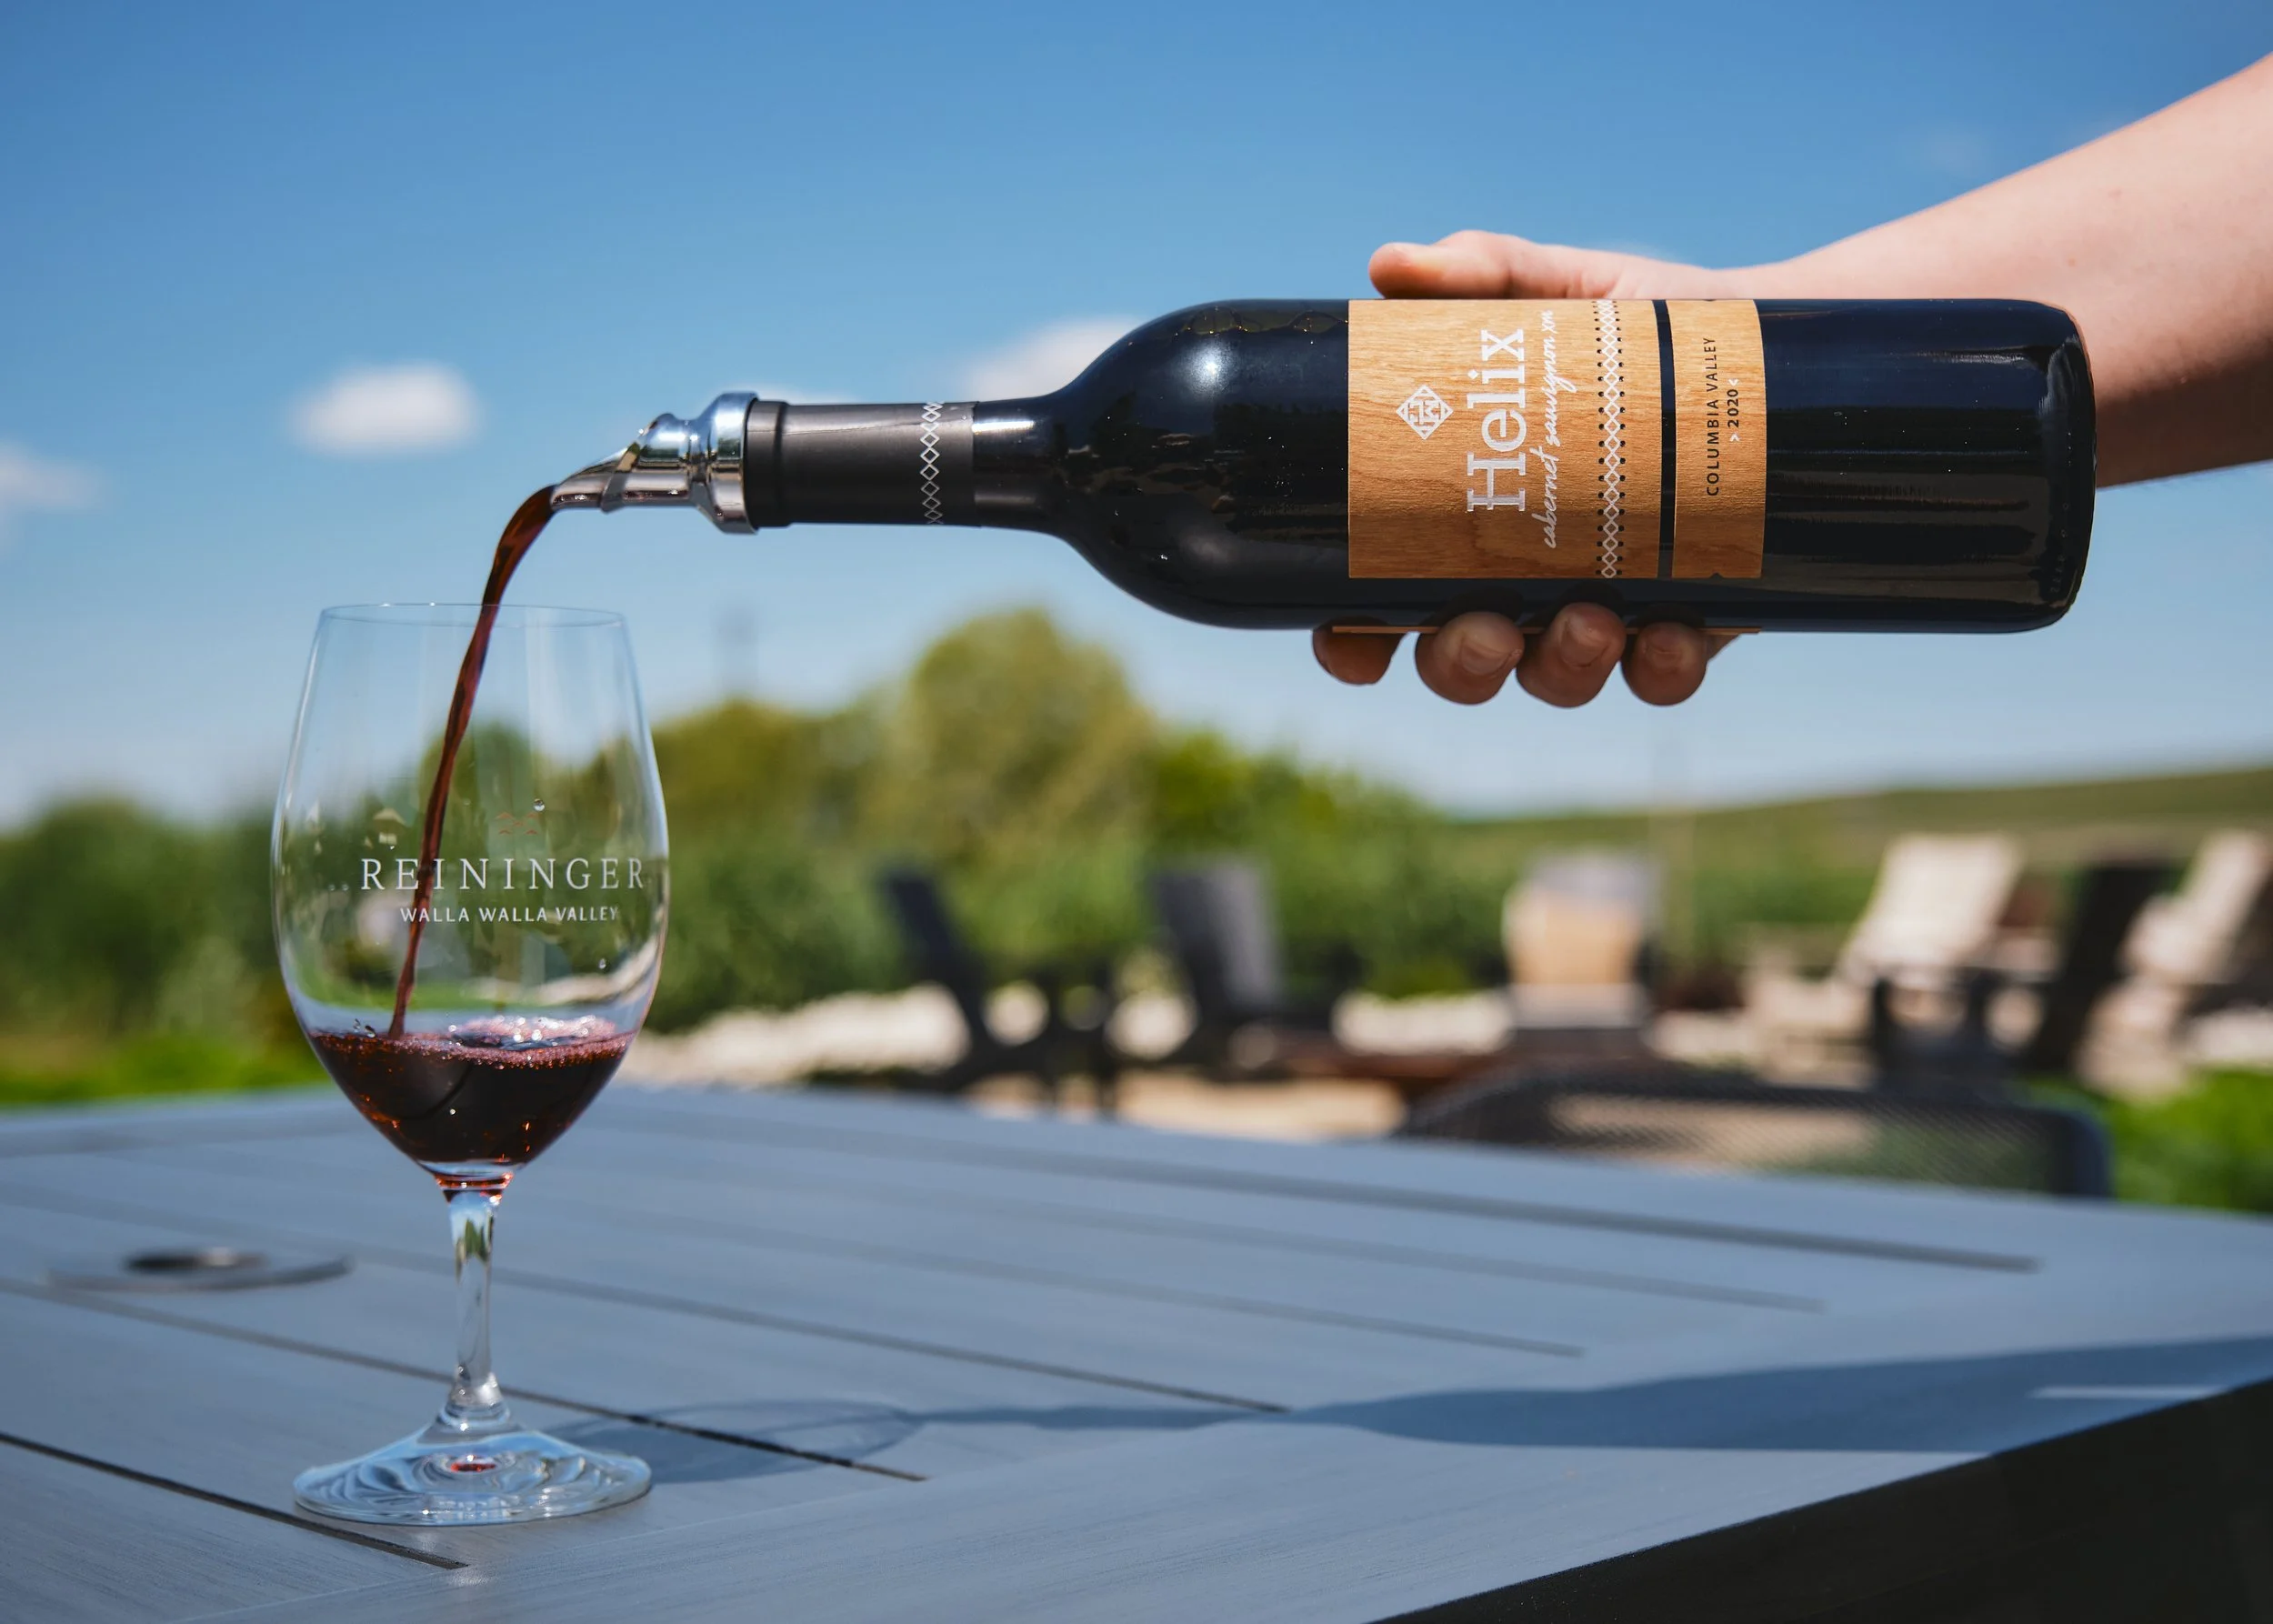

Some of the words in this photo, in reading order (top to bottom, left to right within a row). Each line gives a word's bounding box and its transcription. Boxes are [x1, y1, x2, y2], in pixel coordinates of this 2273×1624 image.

[1541, 336, 1577, 446] sauvignon
[1703, 337, 1718, 392] VALLEY
[1466, 328, 1527, 511] Helix
[1727, 388, 1739, 428] 2020
[1706, 399, 1720, 496] COLUMBIA
[1529, 446, 1560, 548] cabernet
[361, 857, 644, 890] REININGER
[399, 907, 470, 923] WALLA
[478, 907, 547, 923] WALLA
[556, 906, 619, 922] VALLEY
